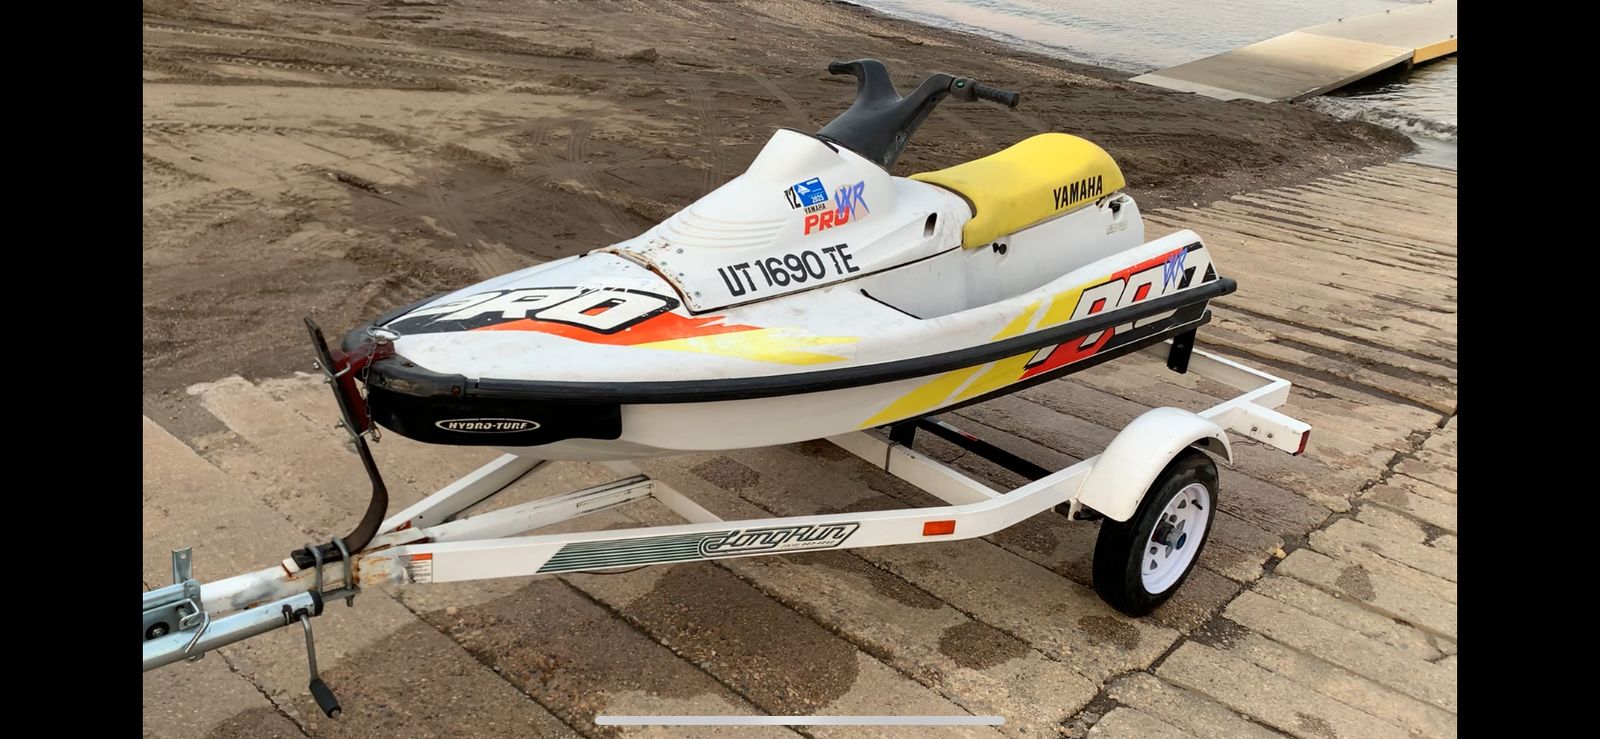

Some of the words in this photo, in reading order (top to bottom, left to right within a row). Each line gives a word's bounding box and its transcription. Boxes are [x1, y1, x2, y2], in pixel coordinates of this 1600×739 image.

[784, 186, 802, 209] 12
[811, 194, 825, 204] 2025
[1053, 174, 1104, 210] YAMAHA
[804, 203, 826, 214] YAMAHA
[804, 207, 849, 236] PRO
[718, 262, 759, 297] UT
[756, 250, 824, 286] 1690
[820, 243, 859, 274] TE
[406, 285, 681, 334] PRO
[448, 422, 528, 430] HYDRO-TURF
